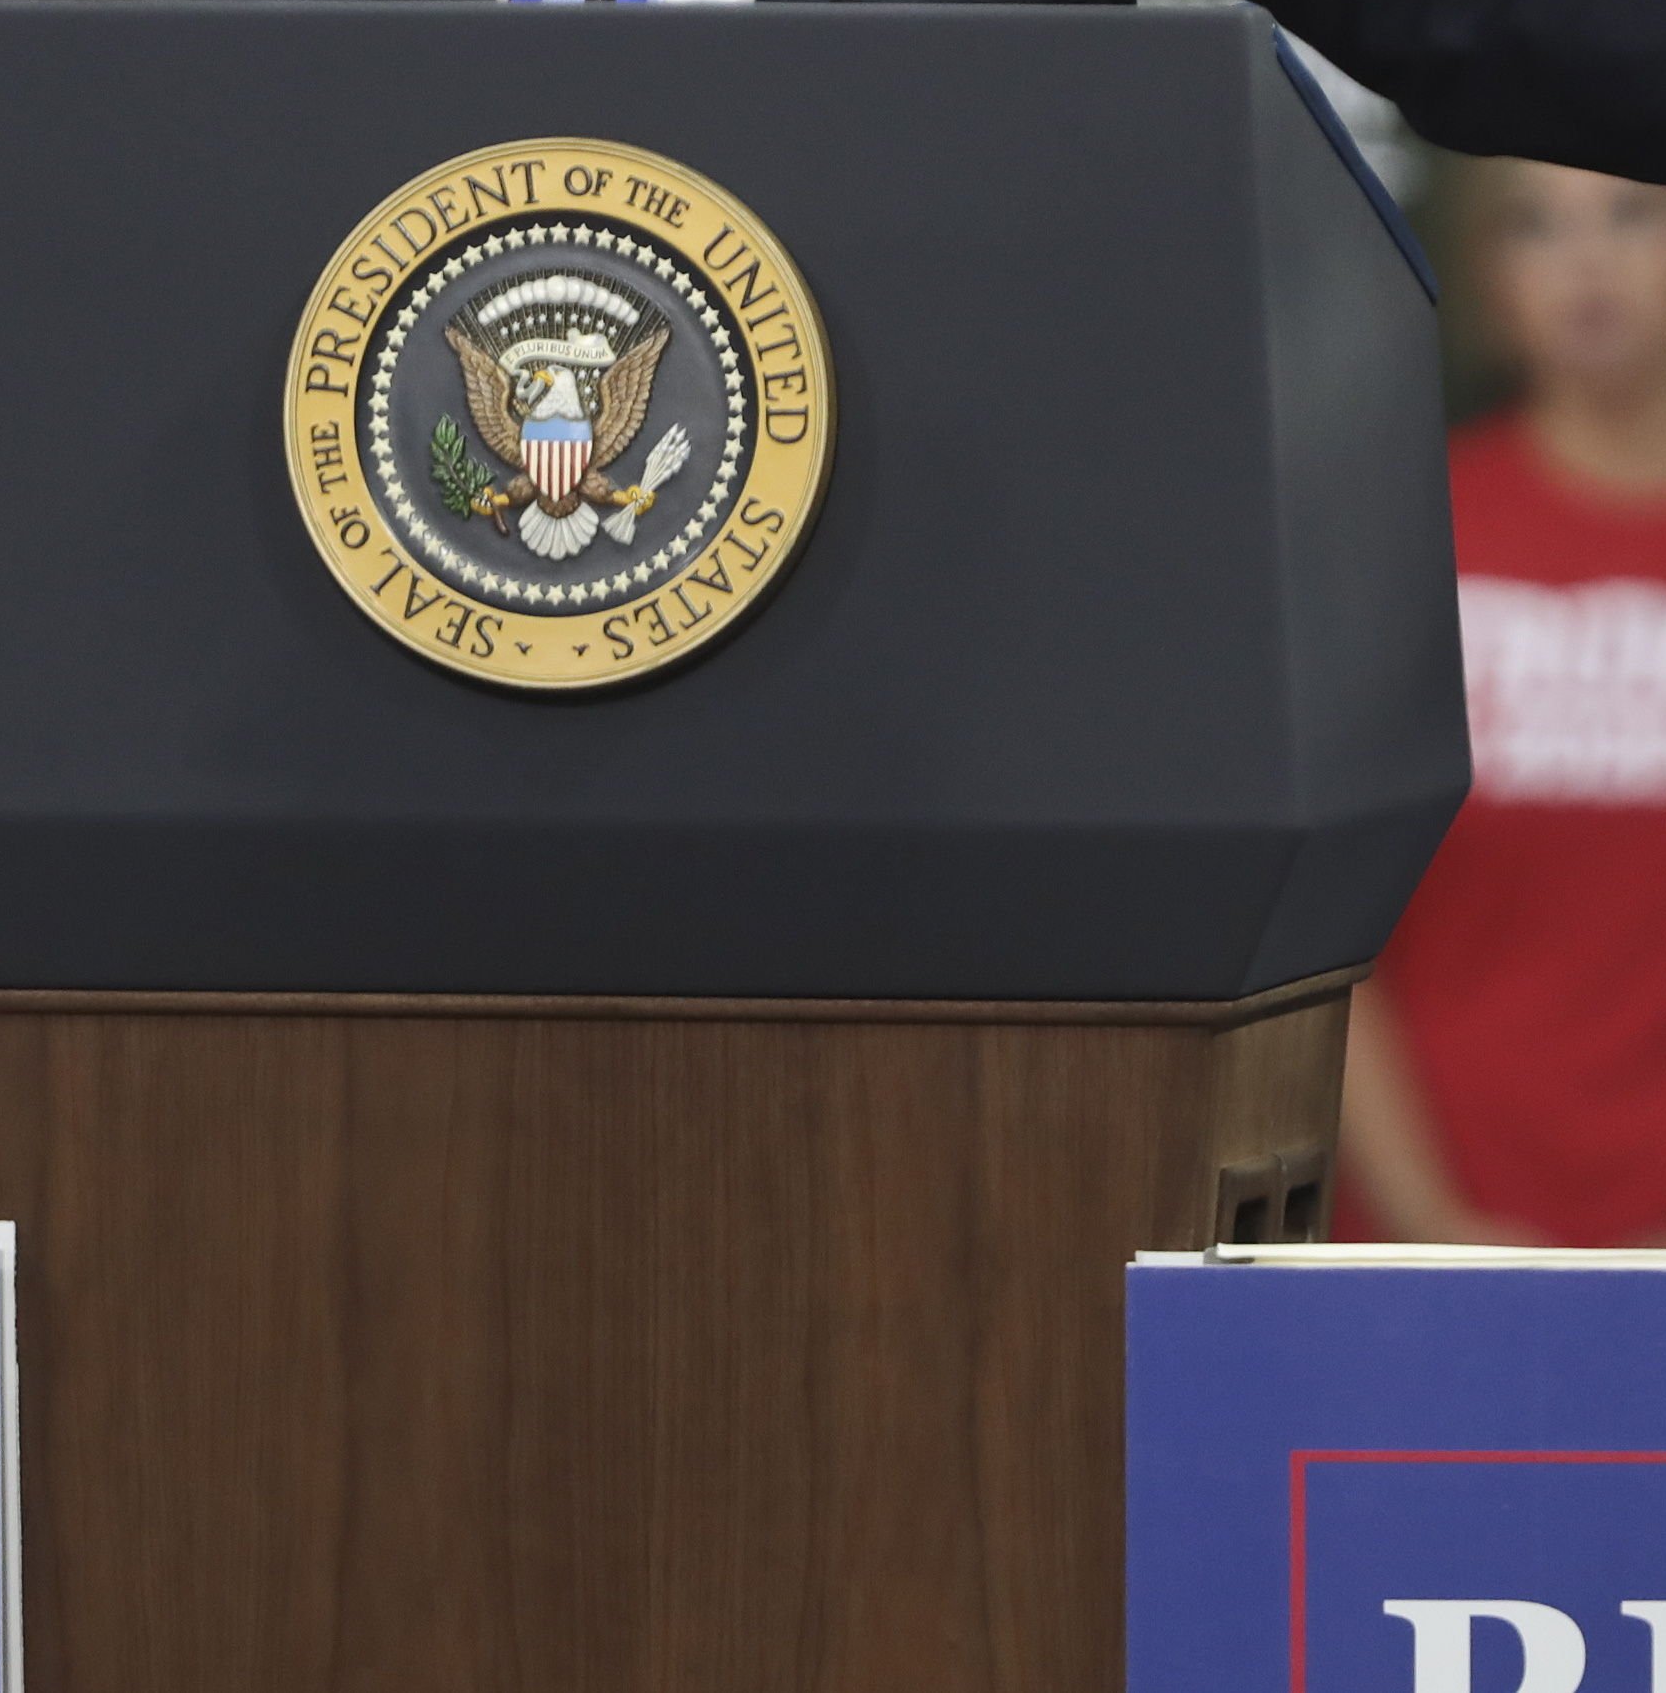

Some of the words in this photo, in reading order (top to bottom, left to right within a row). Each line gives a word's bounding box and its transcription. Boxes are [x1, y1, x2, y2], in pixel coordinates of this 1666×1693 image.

[564, 165, 613, 198] OF
[625, 175, 692, 228] THE
[305, 159, 546, 398] PRESIDENT
[505, 354, 515, 365] E
[515, 342, 572, 357] PLURIBUS
[573, 348, 609, 360] UNUM
[703, 223, 809, 445] UNITED
[310, 420, 348, 494] THE
[329, 504, 370, 550] OF
[369, 549, 504, 659] SEAL
[602, 497, 786, 661] STATES
